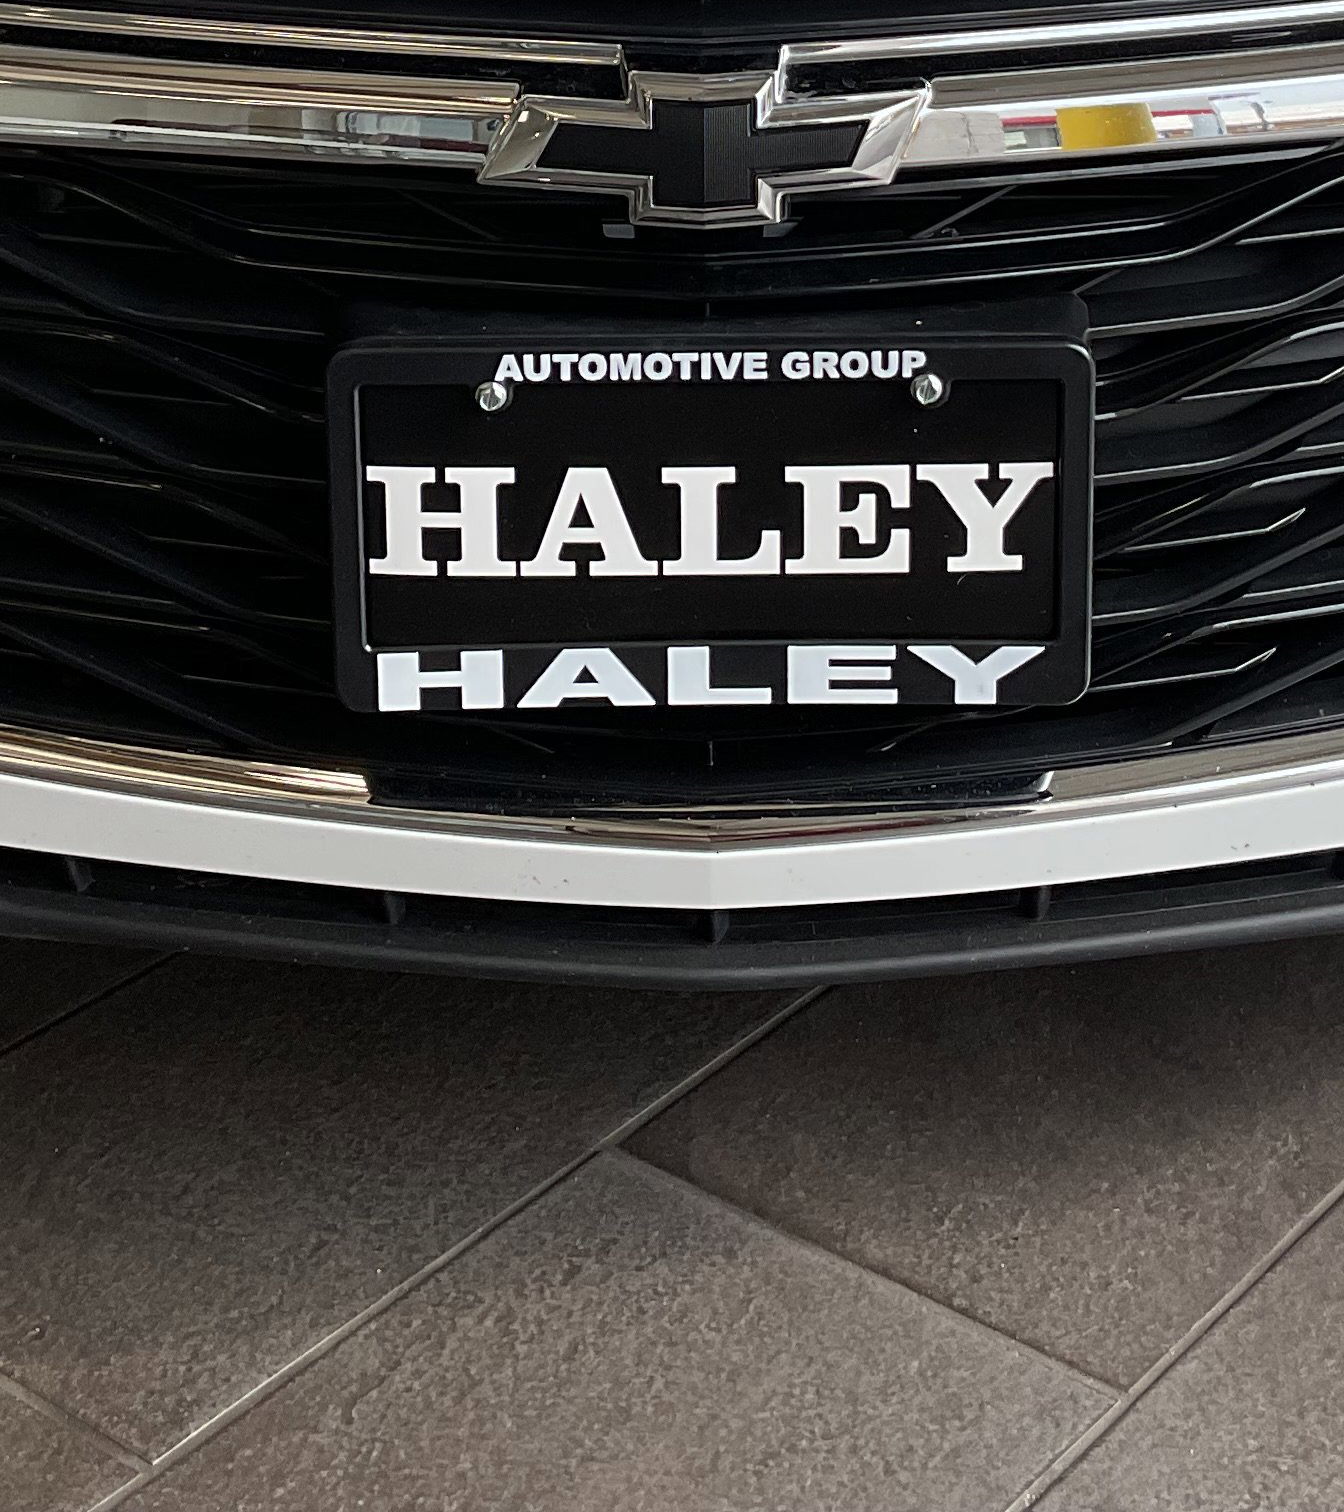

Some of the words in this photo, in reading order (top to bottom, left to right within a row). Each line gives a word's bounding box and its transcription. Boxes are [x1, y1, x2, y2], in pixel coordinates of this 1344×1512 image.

[494, 351, 769, 382] AUTOMOTIVE
[780, 350, 927, 380] GROUP
[365, 461, 1054, 577] HALEY
[376, 644, 1046, 712] HALEY
